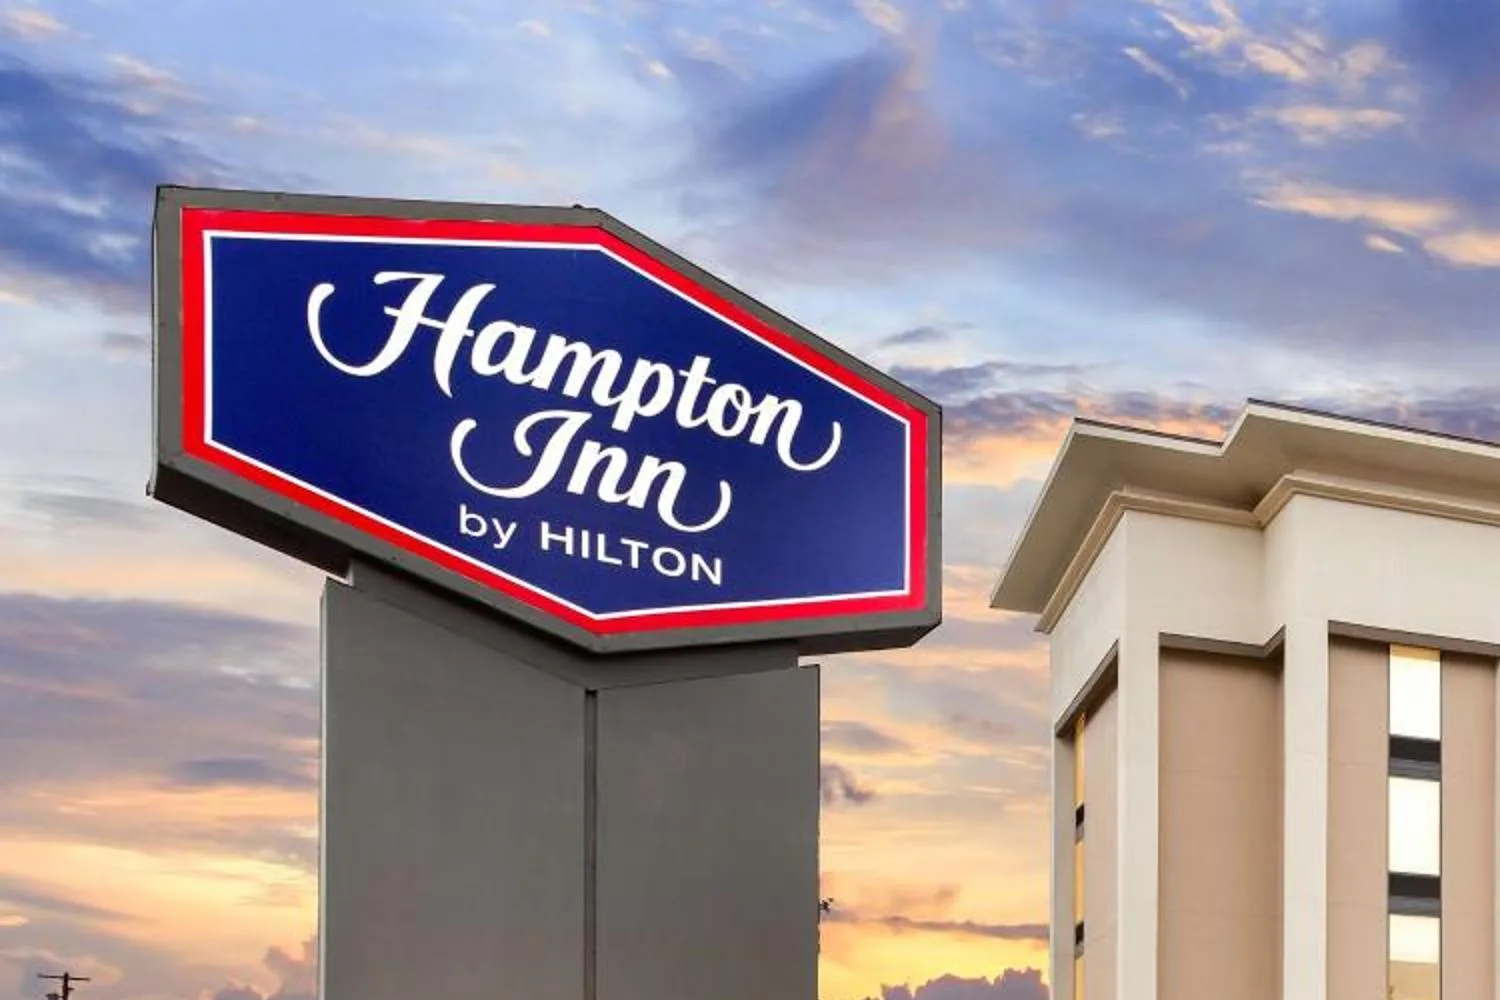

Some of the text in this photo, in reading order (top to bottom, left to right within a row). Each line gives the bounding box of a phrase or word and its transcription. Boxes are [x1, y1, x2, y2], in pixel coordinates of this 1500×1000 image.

[307, 270, 843, 471] Hampton
[450, 408, 731, 533] Inn
[458, 503, 723, 586] by HILTON
